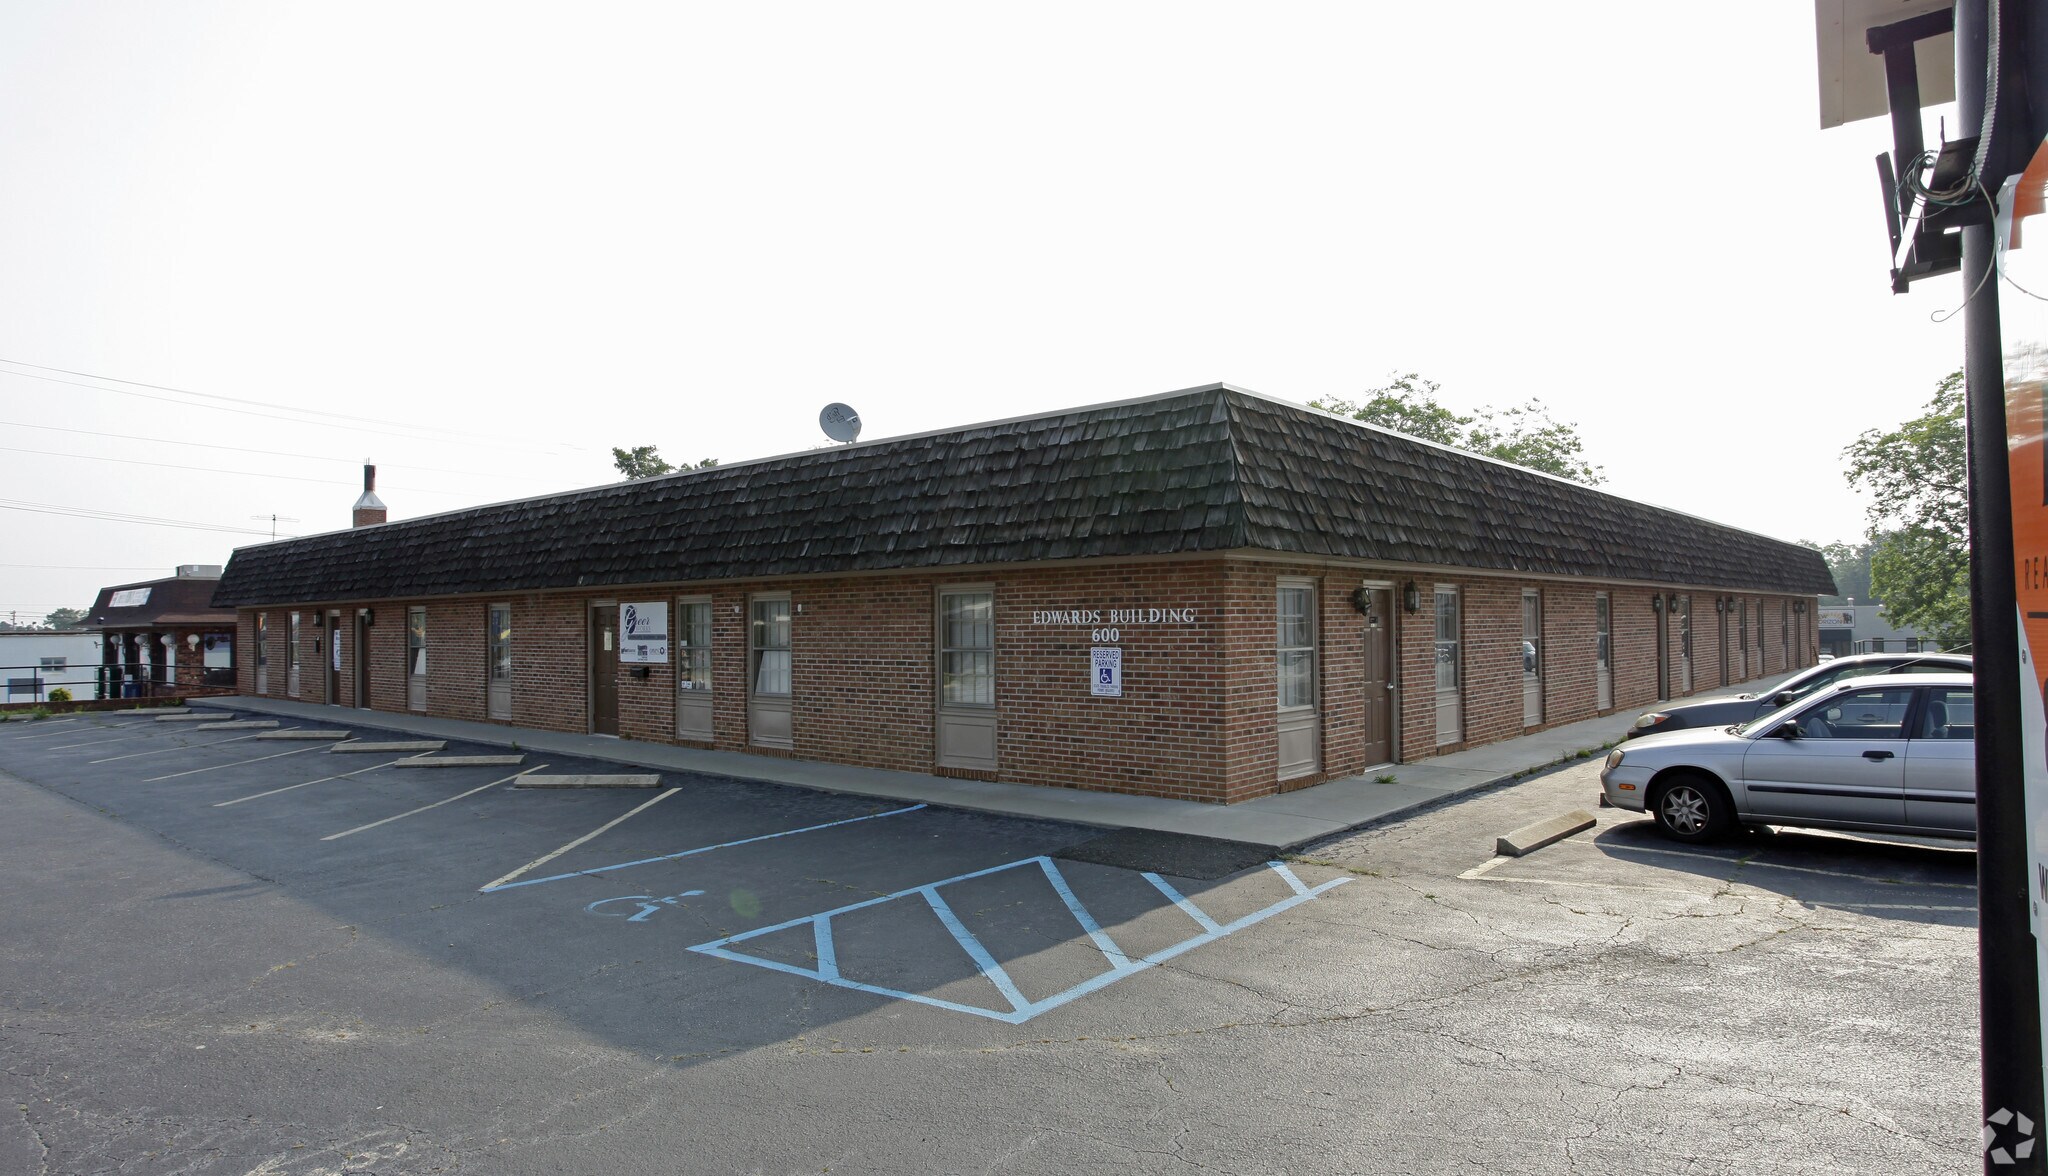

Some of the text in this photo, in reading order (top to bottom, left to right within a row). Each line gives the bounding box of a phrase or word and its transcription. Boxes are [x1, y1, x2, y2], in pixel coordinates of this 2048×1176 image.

[1033, 608, 1195, 624] EDWARDS BUILDING
[1092, 628, 1119, 642] 600
[1093, 650, 1119, 659] RESERVED
[1095, 659, 1117, 668] PARKING
